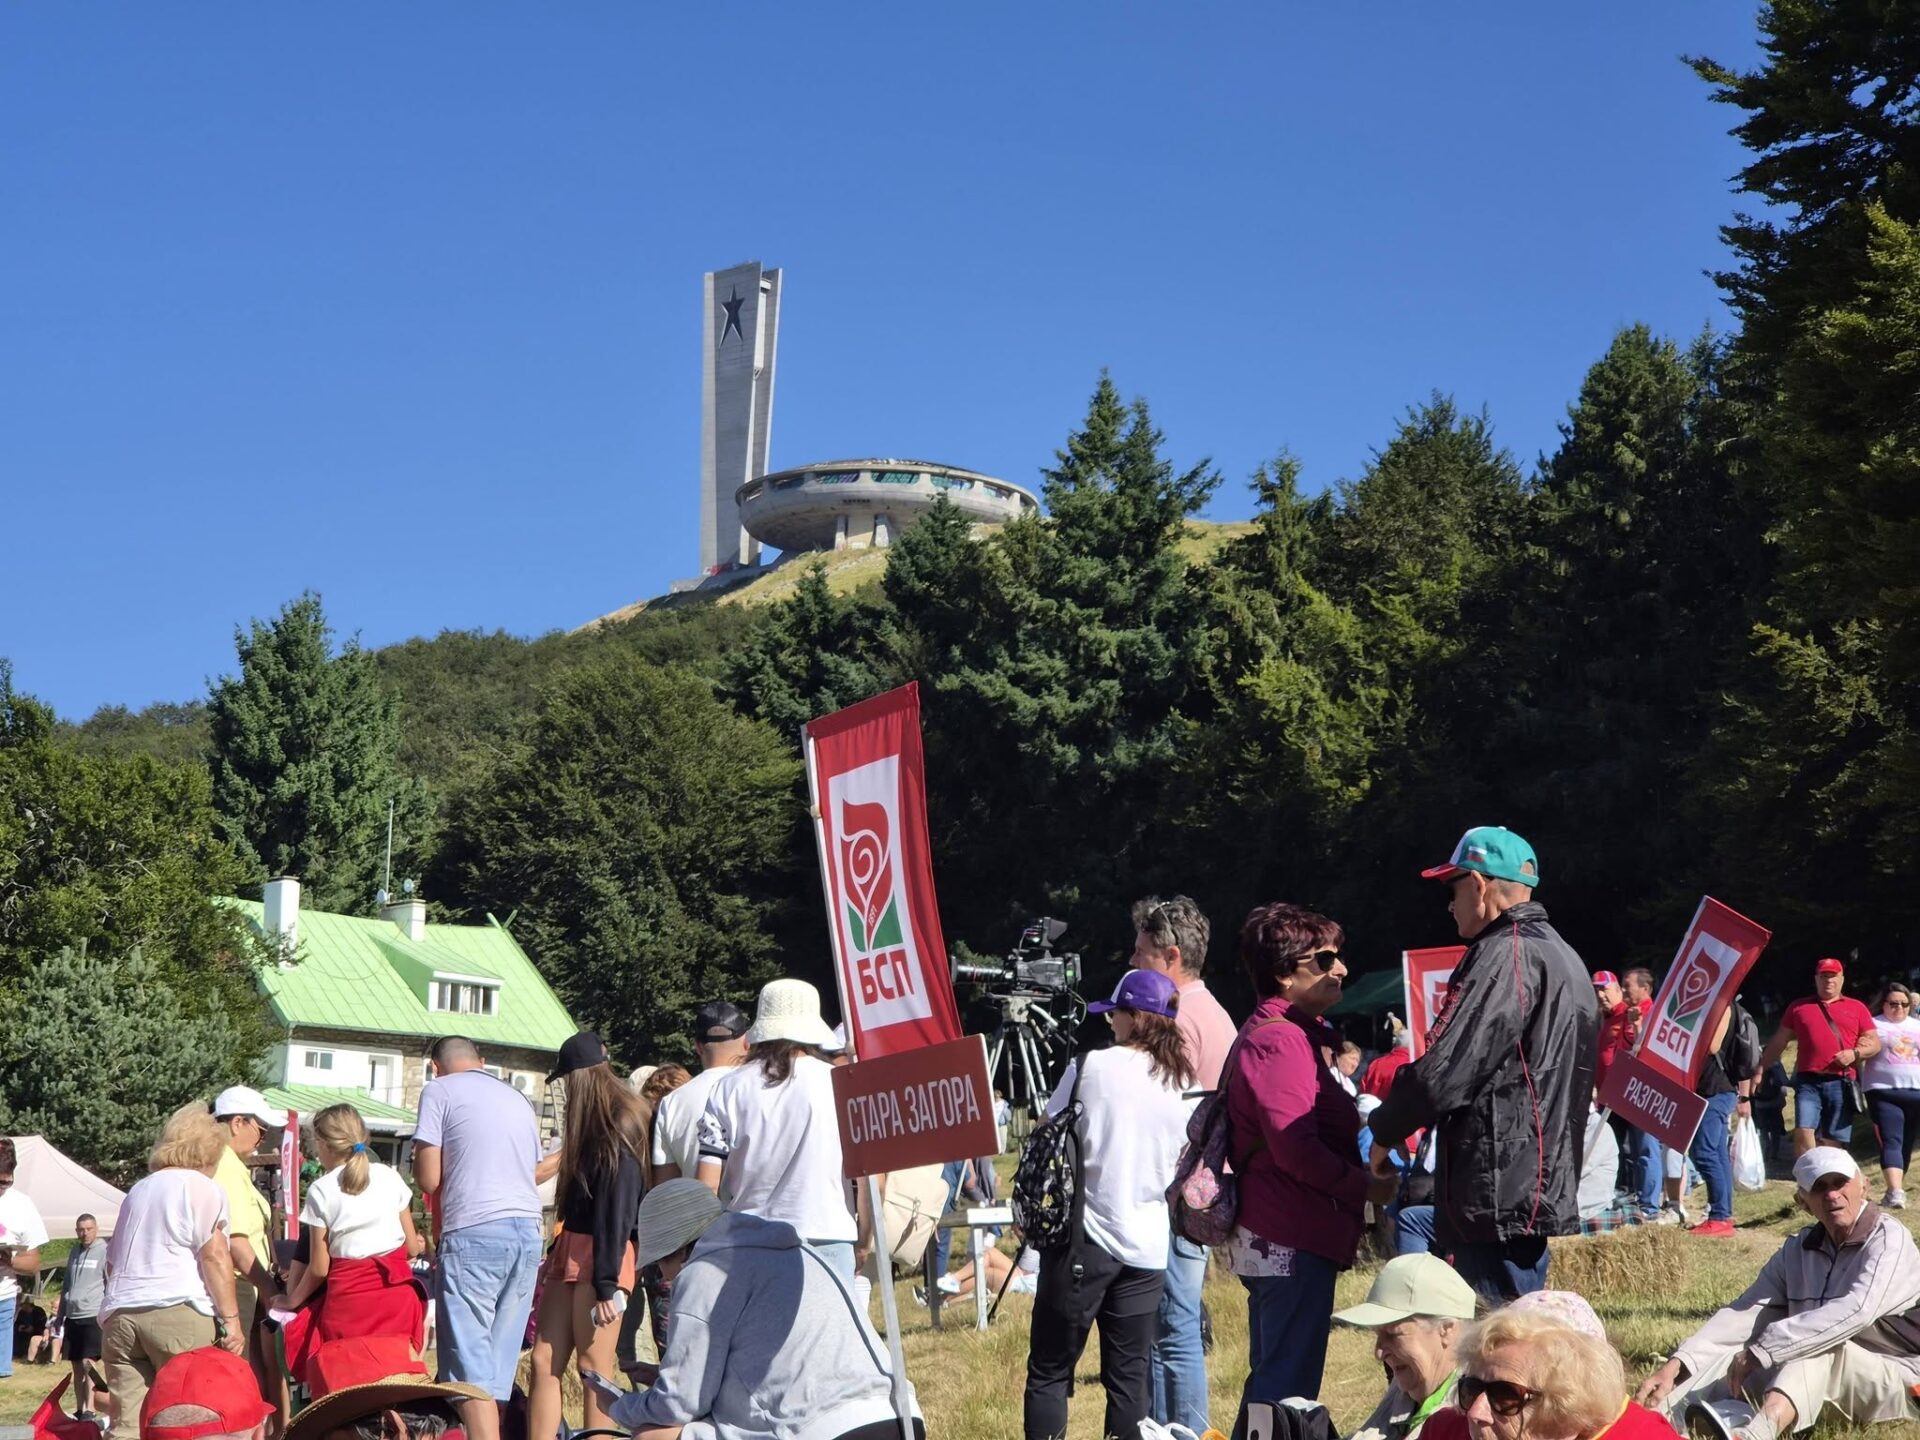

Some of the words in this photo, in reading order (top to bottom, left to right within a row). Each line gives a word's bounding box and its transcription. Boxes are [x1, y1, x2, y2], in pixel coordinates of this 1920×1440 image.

[857, 949, 914, 1005] БСП
[1656, 1019, 1690, 1057] БСП
[847, 1090, 905, 1143] СТАРА
[904, 1074, 980, 1133] ЗАГОРА
[1623, 1076, 1677, 1128] РАЗГРАД
